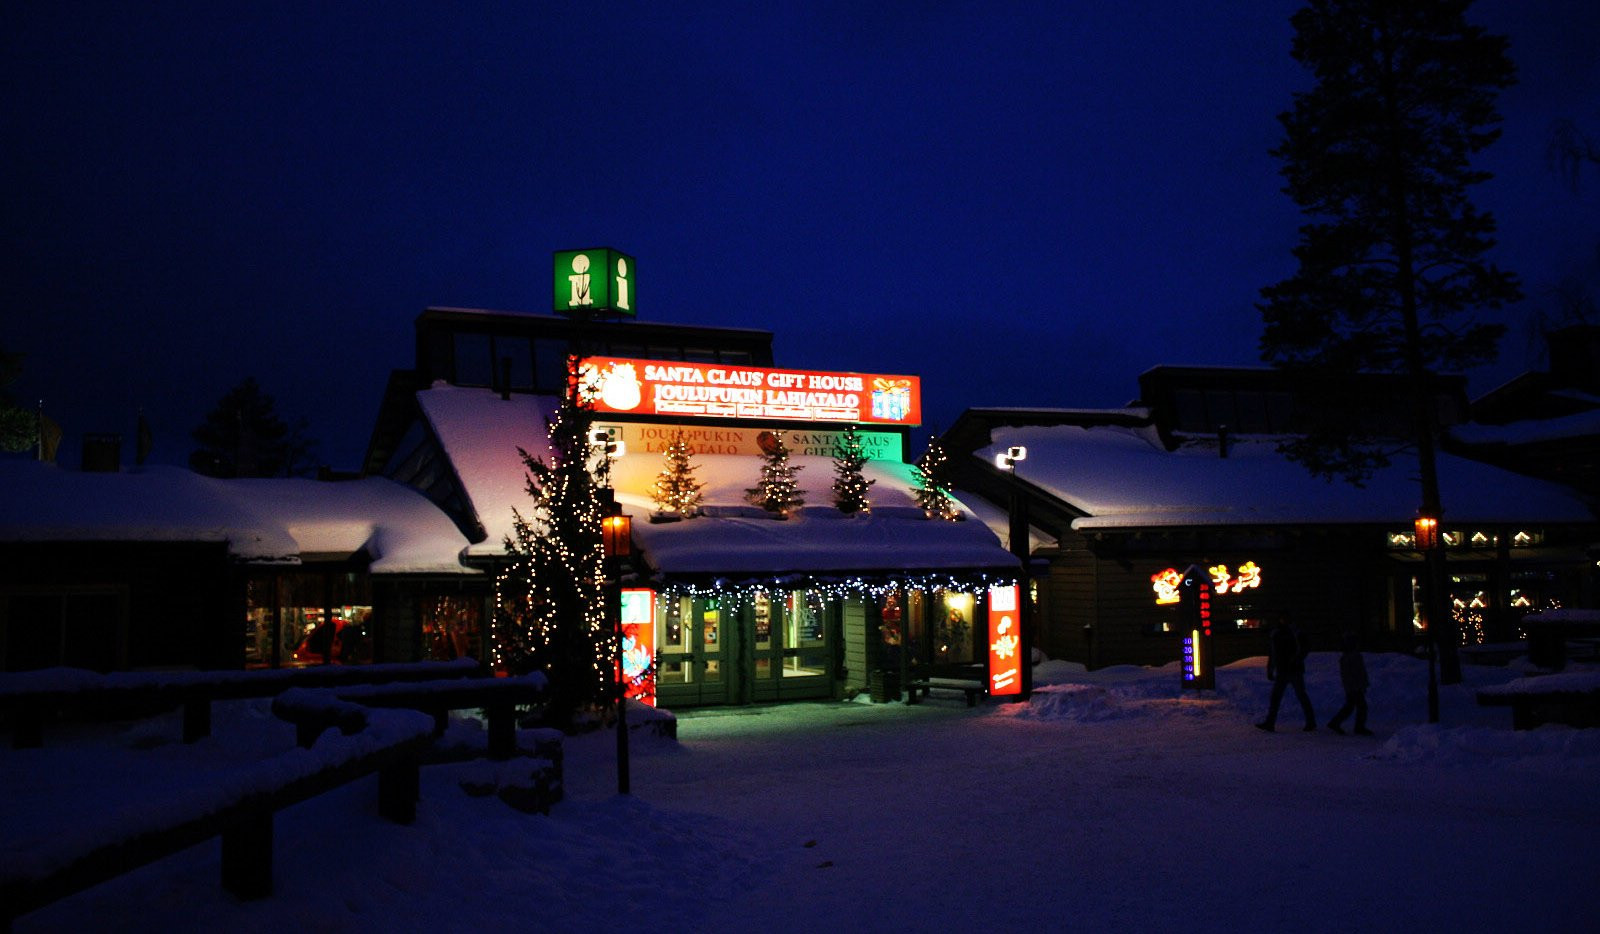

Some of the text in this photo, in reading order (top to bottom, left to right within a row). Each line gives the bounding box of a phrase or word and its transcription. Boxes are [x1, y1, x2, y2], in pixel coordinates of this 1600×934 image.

[645, 365, 863, 391] SANTA CLAUS' GIFT HOUSE
[654, 384, 859, 408] JOULUPUKIN LAHJATALO
[792, 433, 841, 445] SANTA
